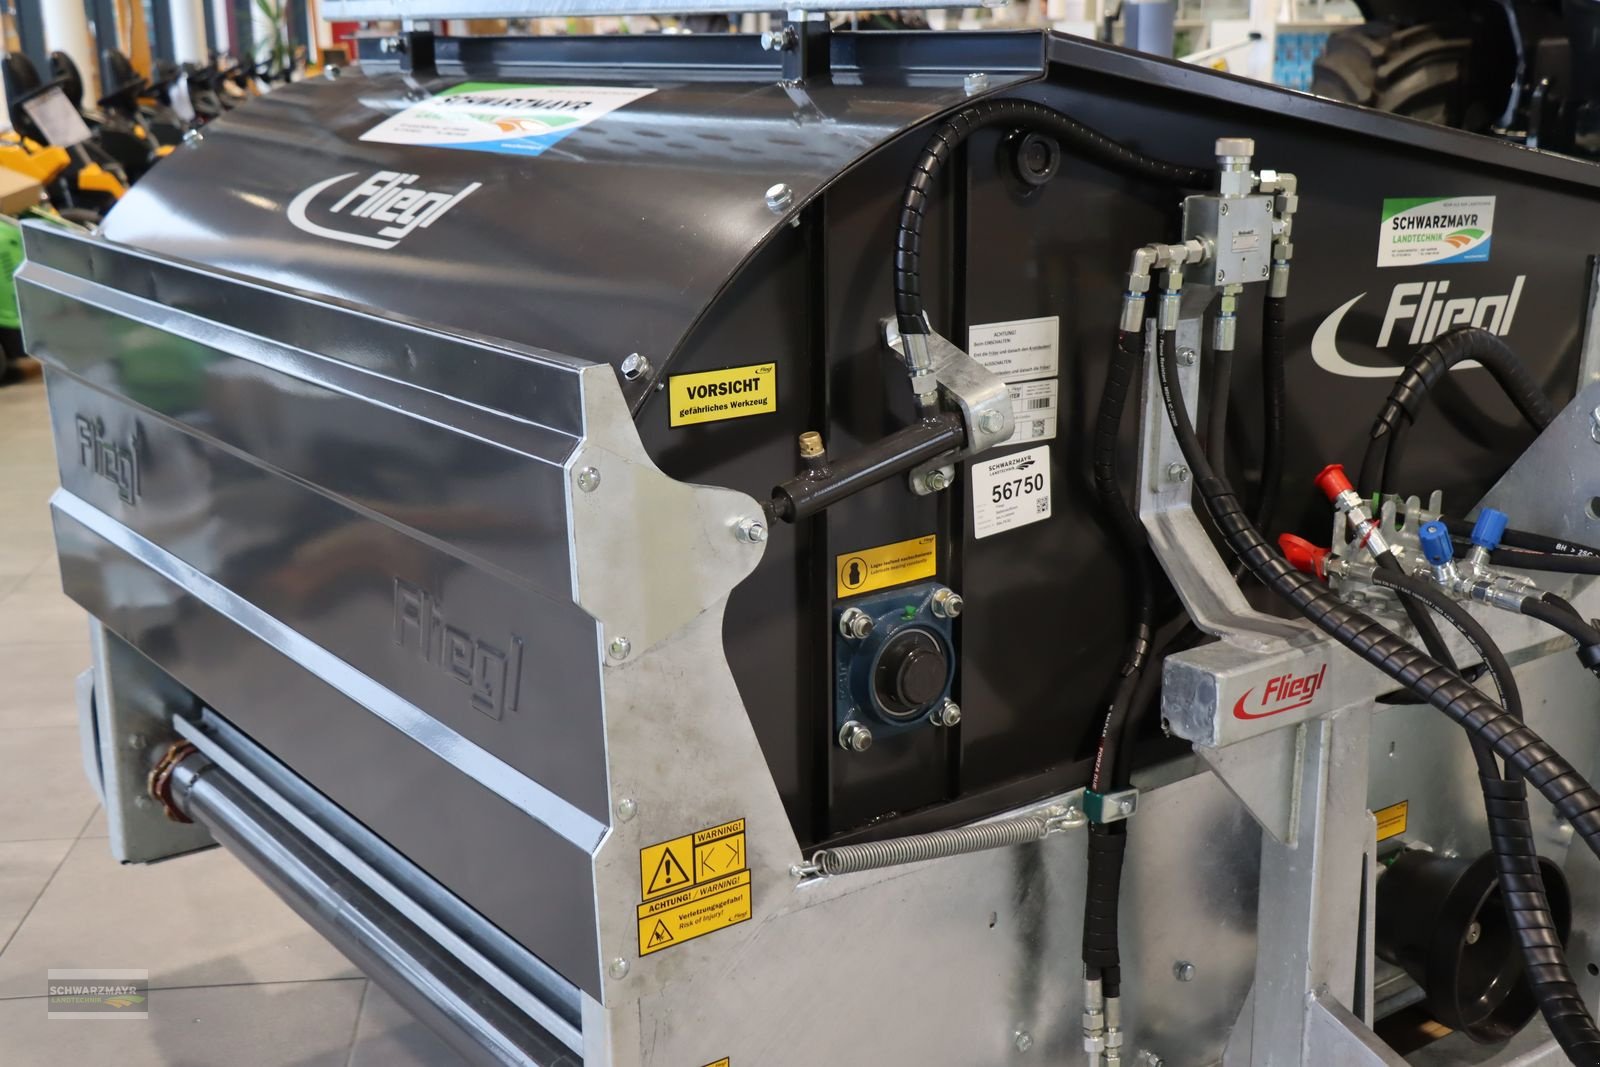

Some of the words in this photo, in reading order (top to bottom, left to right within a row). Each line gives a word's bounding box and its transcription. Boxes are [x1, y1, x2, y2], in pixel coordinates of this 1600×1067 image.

[329, 170, 482, 239] Fliegl
[1392, 214, 1478, 230] SCHWARZMAYR
[1392, 233, 1443, 244] LANDTECHNIK
[687, 378, 760, 400] VORSICHT
[680, 403, 728, 418] gefährliches
[730, 397, 768, 409] Werkzeug
[75, 413, 141, 506] Fliegl
[988, 455, 1032, 472] SCHWARZMAYR
[992, 473, 1044, 503] 56750
[393, 577, 523, 720] Fliegl
[1261, 663, 1327, 706] Fliegl
[698, 822, 741, 842] WARNING!
[649, 892, 692, 912] ACHTUNG!
[700, 877, 740, 896] WARNING!
[678, 894, 743, 921] Verletzungsgefahr!
[679, 918, 694, 930] Risk
[694, 916, 702, 925] of
[703, 910, 724, 923] Injury!
